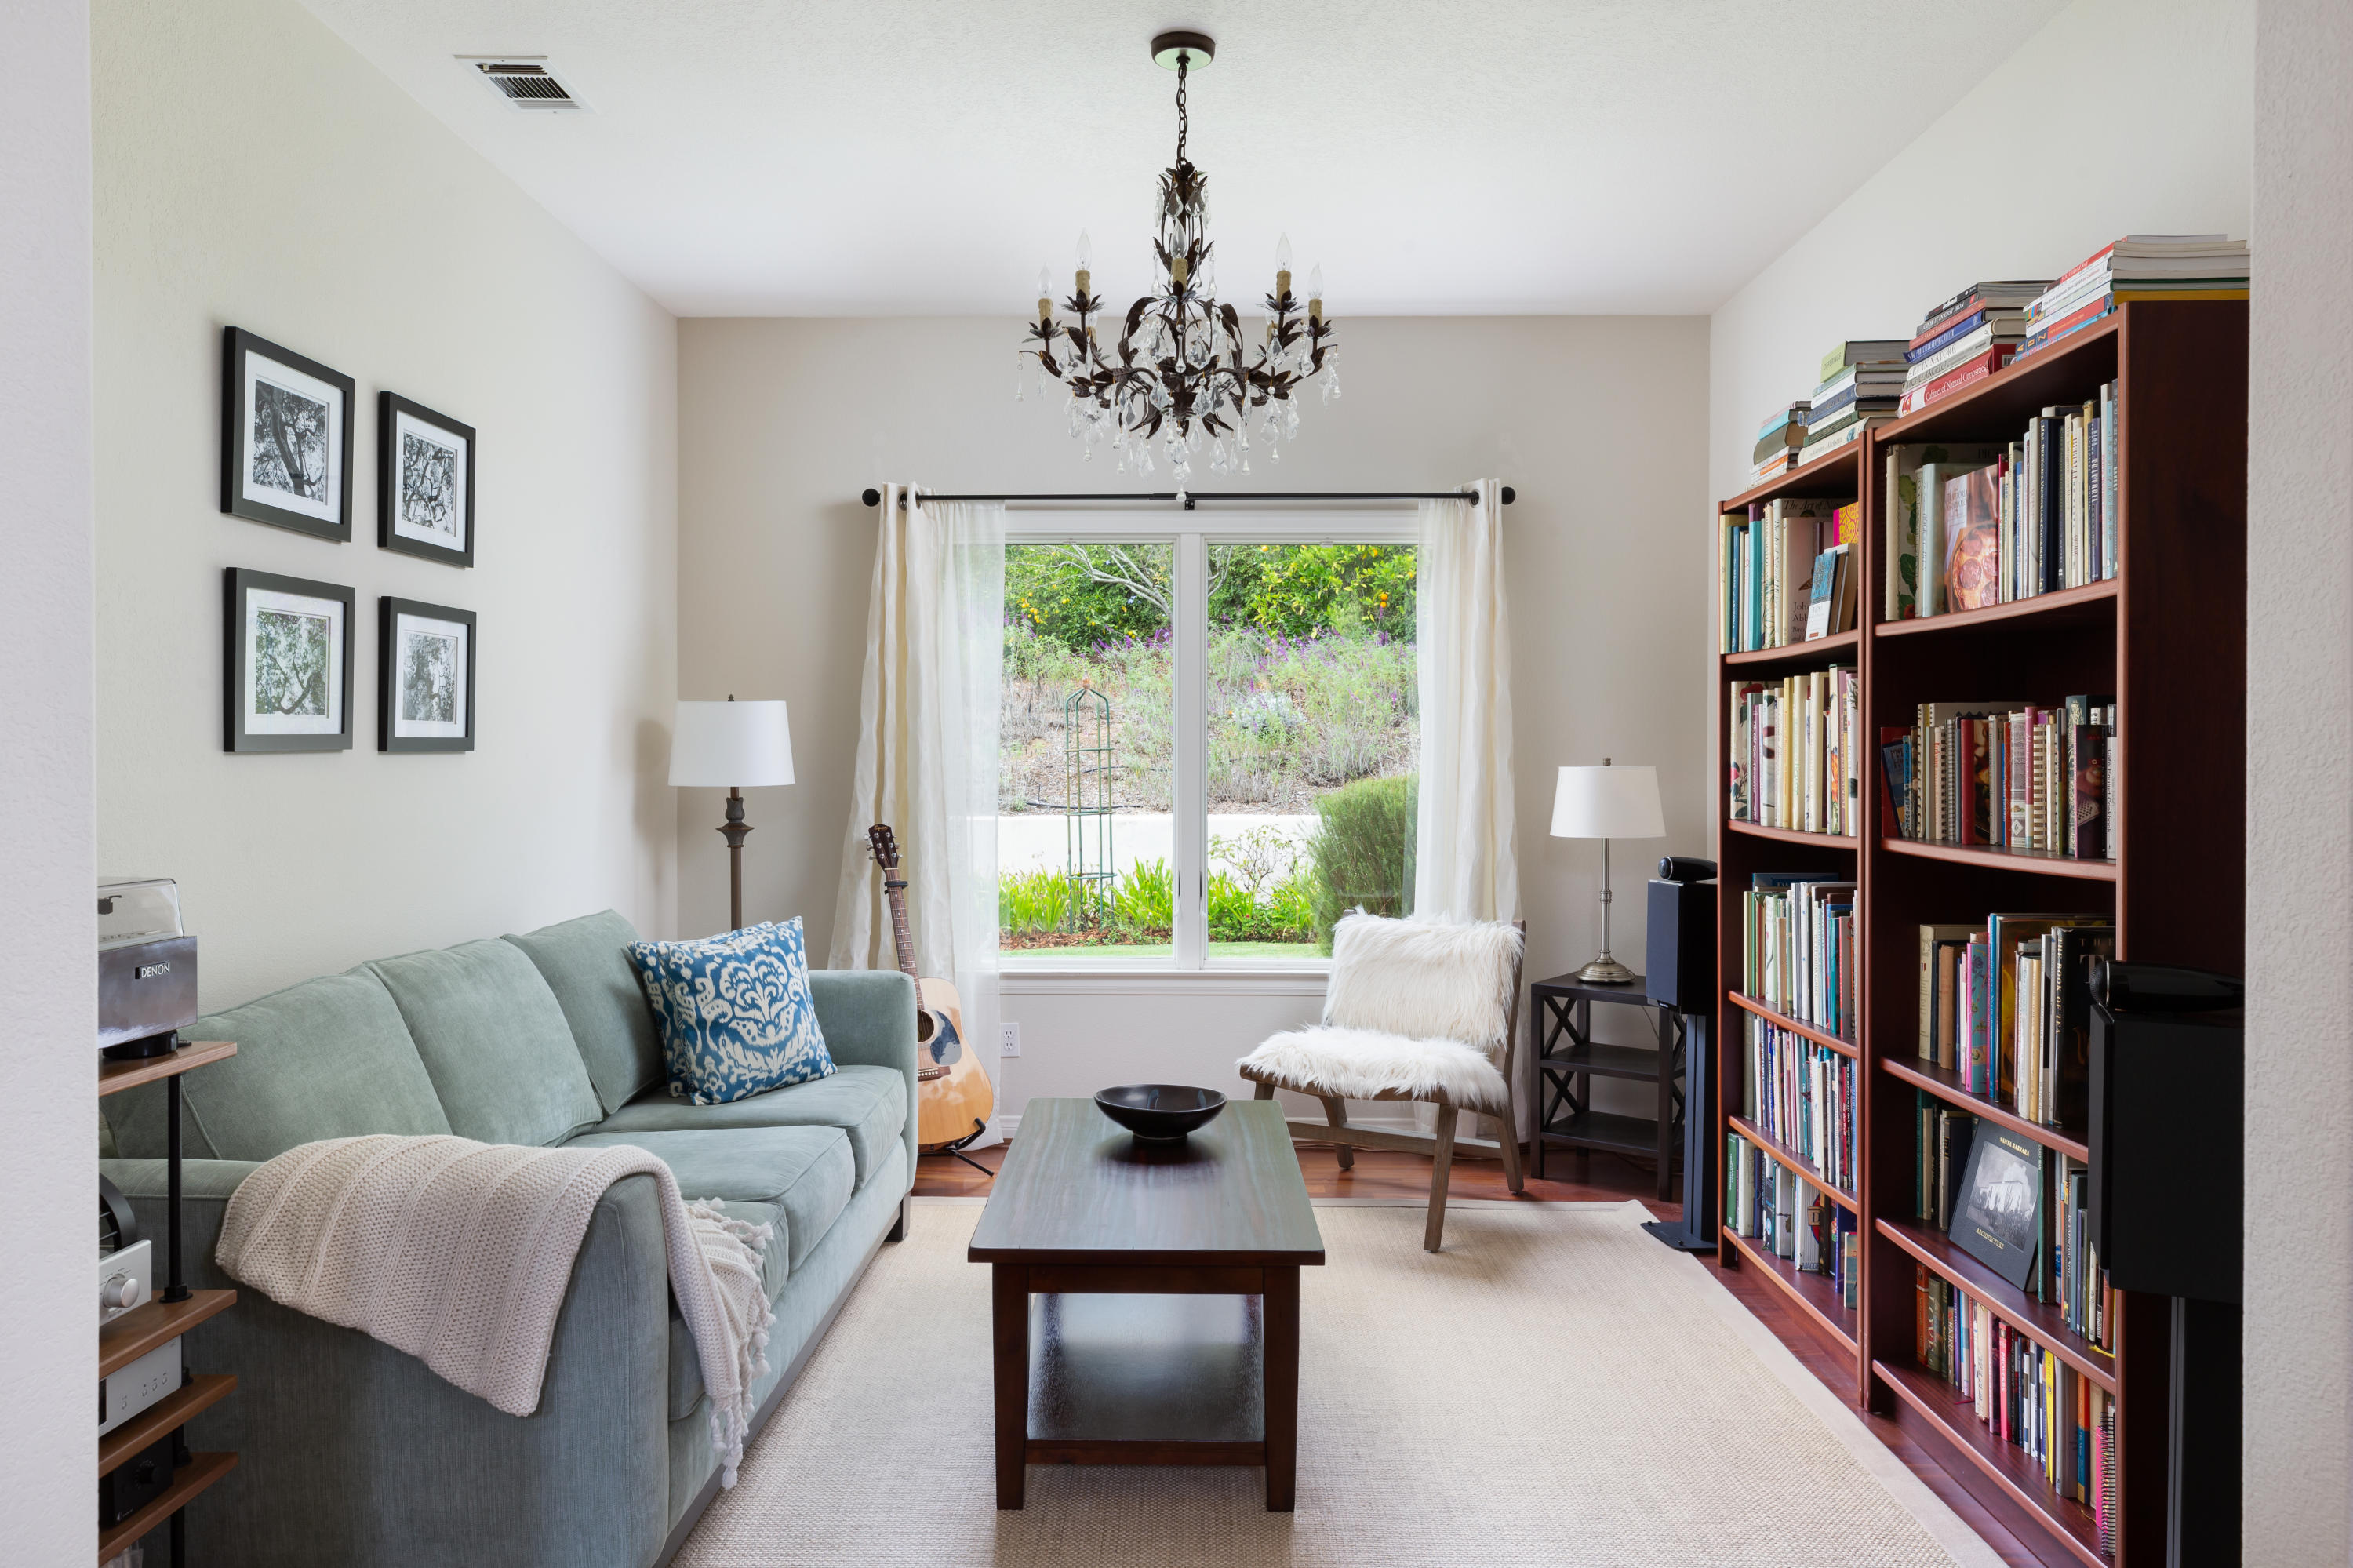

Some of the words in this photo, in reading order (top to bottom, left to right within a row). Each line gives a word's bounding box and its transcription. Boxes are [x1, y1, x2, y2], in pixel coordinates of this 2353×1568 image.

[1944, 309, 1954, 318] CAST
[1954, 302, 1964, 313] IRON
[1910, 366, 1919, 377] ART
[1922, 362, 1928, 372] IN
[1930, 345, 1956, 363] NATURE
[1926, 387, 1943, 402] Cabinet
[1946, 373, 1962, 391] Natural
[1962, 364, 1988, 382] Curiosities
[141, 962, 170, 978] DENON
[2057, 995, 2061, 1010] OF
[1999, 1136, 2013, 1148] SANTA
[2012, 1142, 2030, 1156] BARBARA
[1976, 1227, 2005, 1250] ARCHITECTURE
